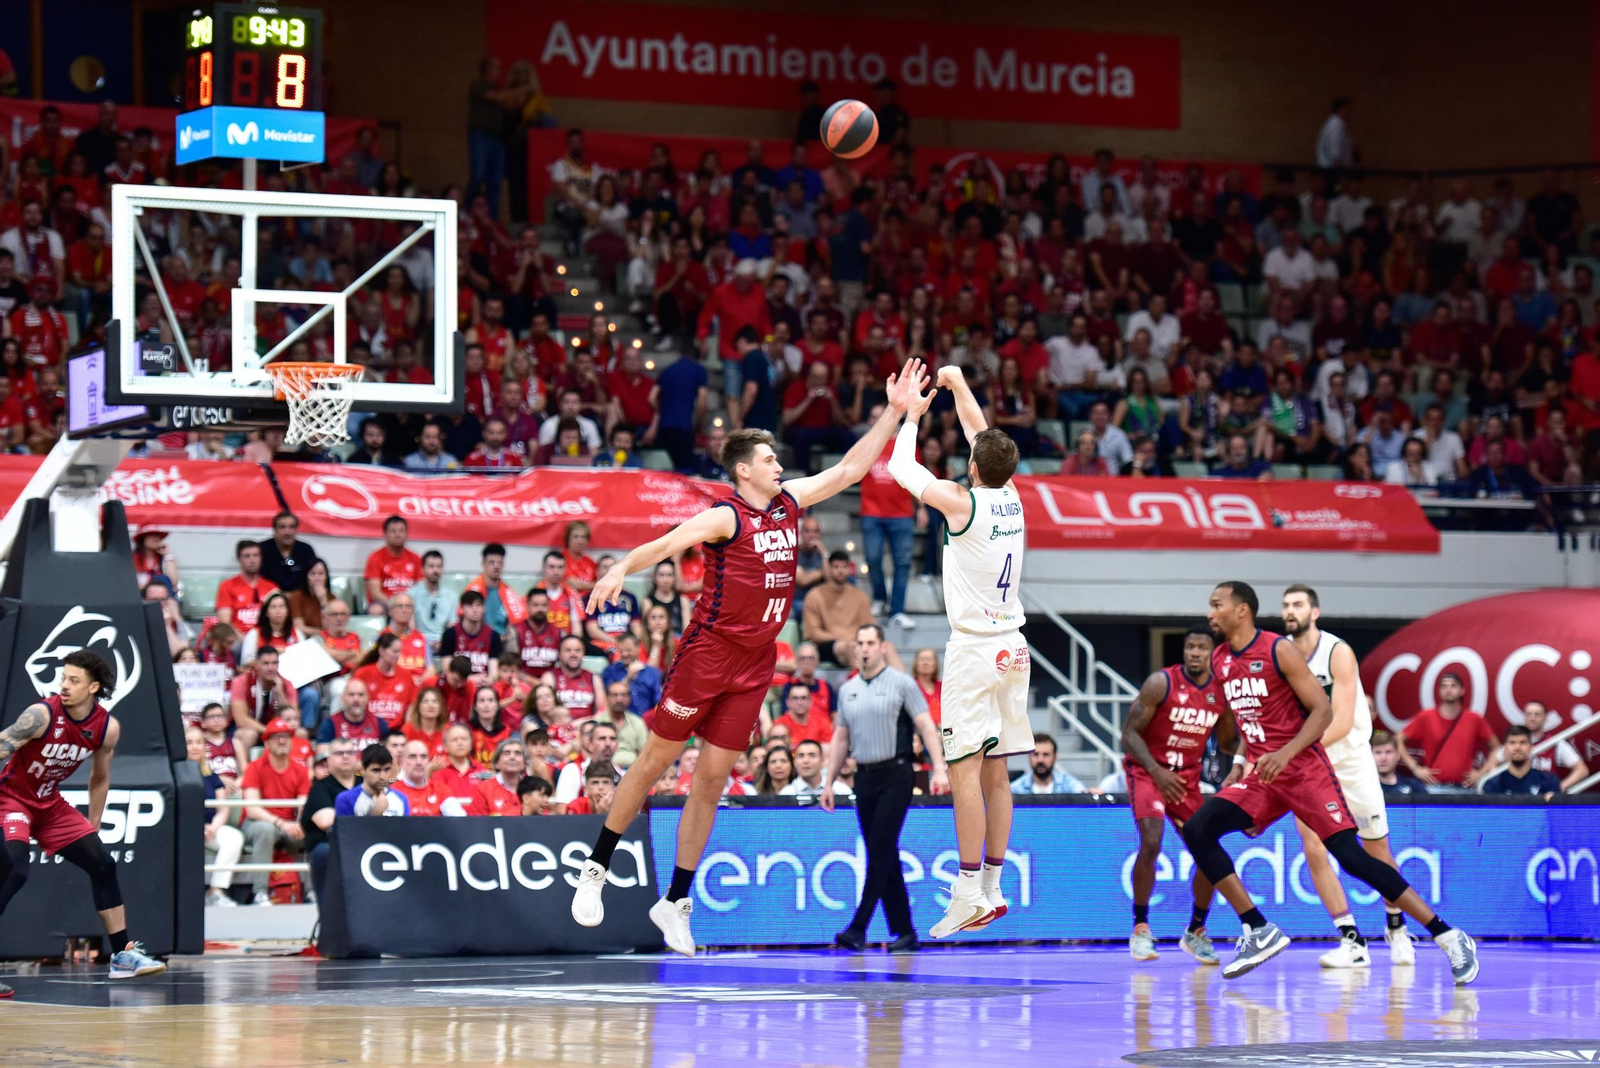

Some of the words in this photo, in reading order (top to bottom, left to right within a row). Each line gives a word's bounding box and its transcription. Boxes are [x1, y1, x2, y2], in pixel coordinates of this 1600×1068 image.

[249, 15, 306, 48] 9:43
[541, 20, 886, 83] Ayuntamiento
[902, 45, 958, 88] de
[975, 49, 1135, 98] Murcia
[276, 54, 306, 108] 8
[264, 128, 315, 144] Movistar
[753, 527, 798, 554] UCAM
[763, 550, 795, 564] MURCIA
[996, 553, 1013, 603] 4
[761, 597, 787, 623] 14
[1222, 676, 1269, 702] UCAM
[1168, 706, 1220, 728] UCAM
[1172, 722, 1208, 736] MURCIA
[1240, 721, 1267, 744] 24
[41, 742, 94, 762] UCAM
[360, 827, 648, 892] endesa
[1120, 832, 1441, 906] edea
[1526, 848, 1600, 905] en
